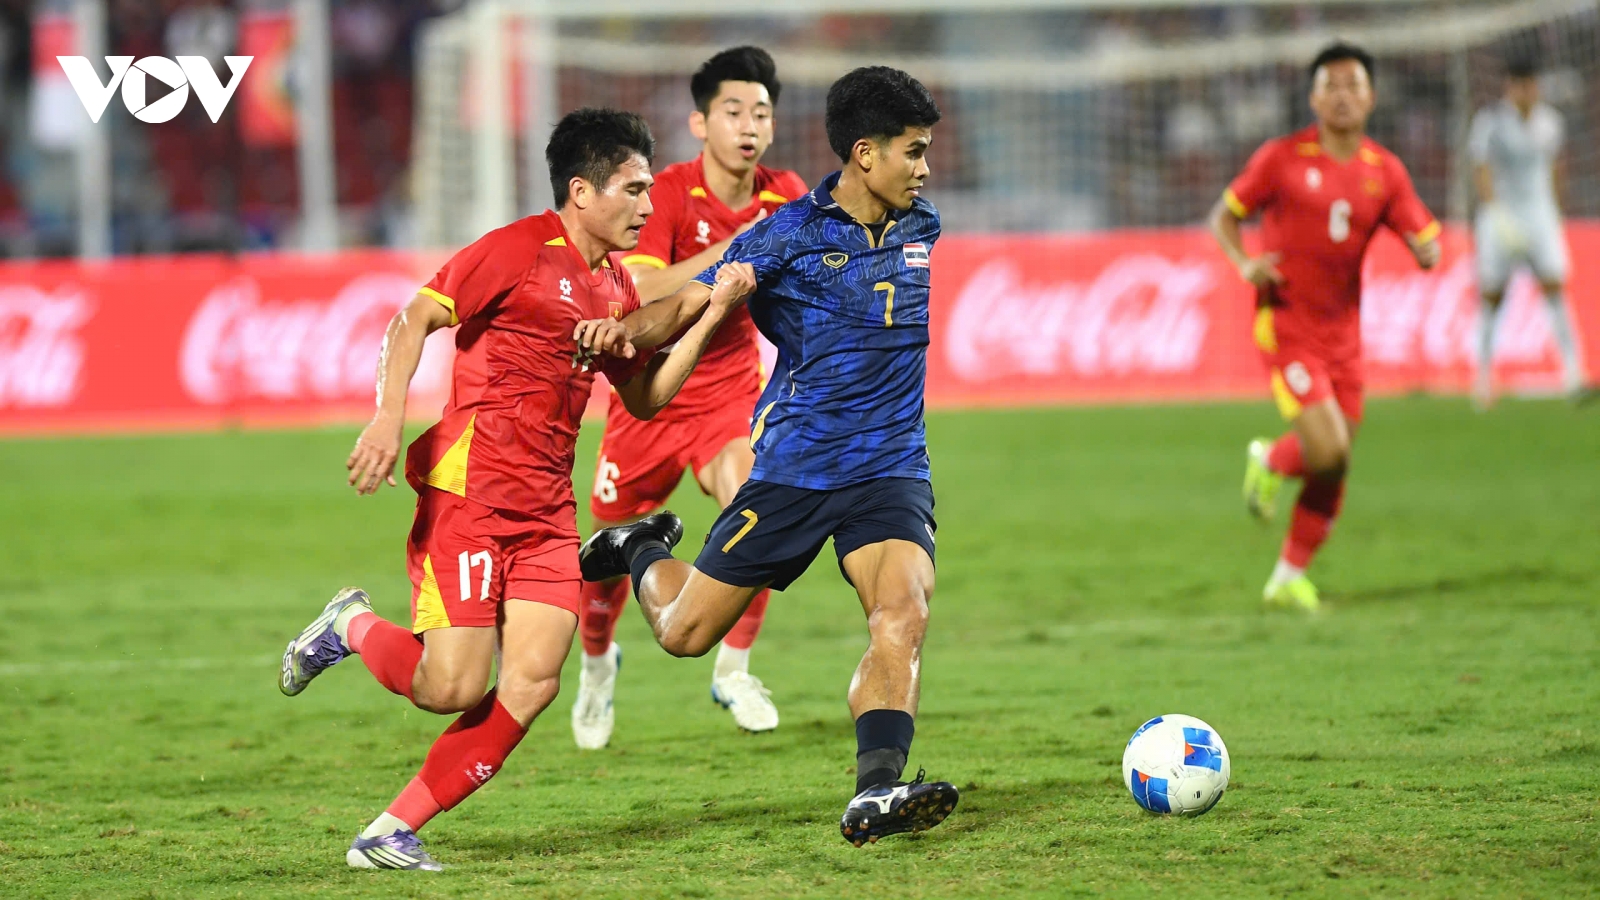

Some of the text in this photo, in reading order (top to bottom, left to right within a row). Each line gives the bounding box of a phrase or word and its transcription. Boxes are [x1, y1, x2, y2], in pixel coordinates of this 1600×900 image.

[1329, 199, 1351, 243] 6
[873, 281, 895, 328] 7
[594, 454, 621, 504] 16
[721, 508, 759, 554] 7
[458, 549, 493, 602] 17
